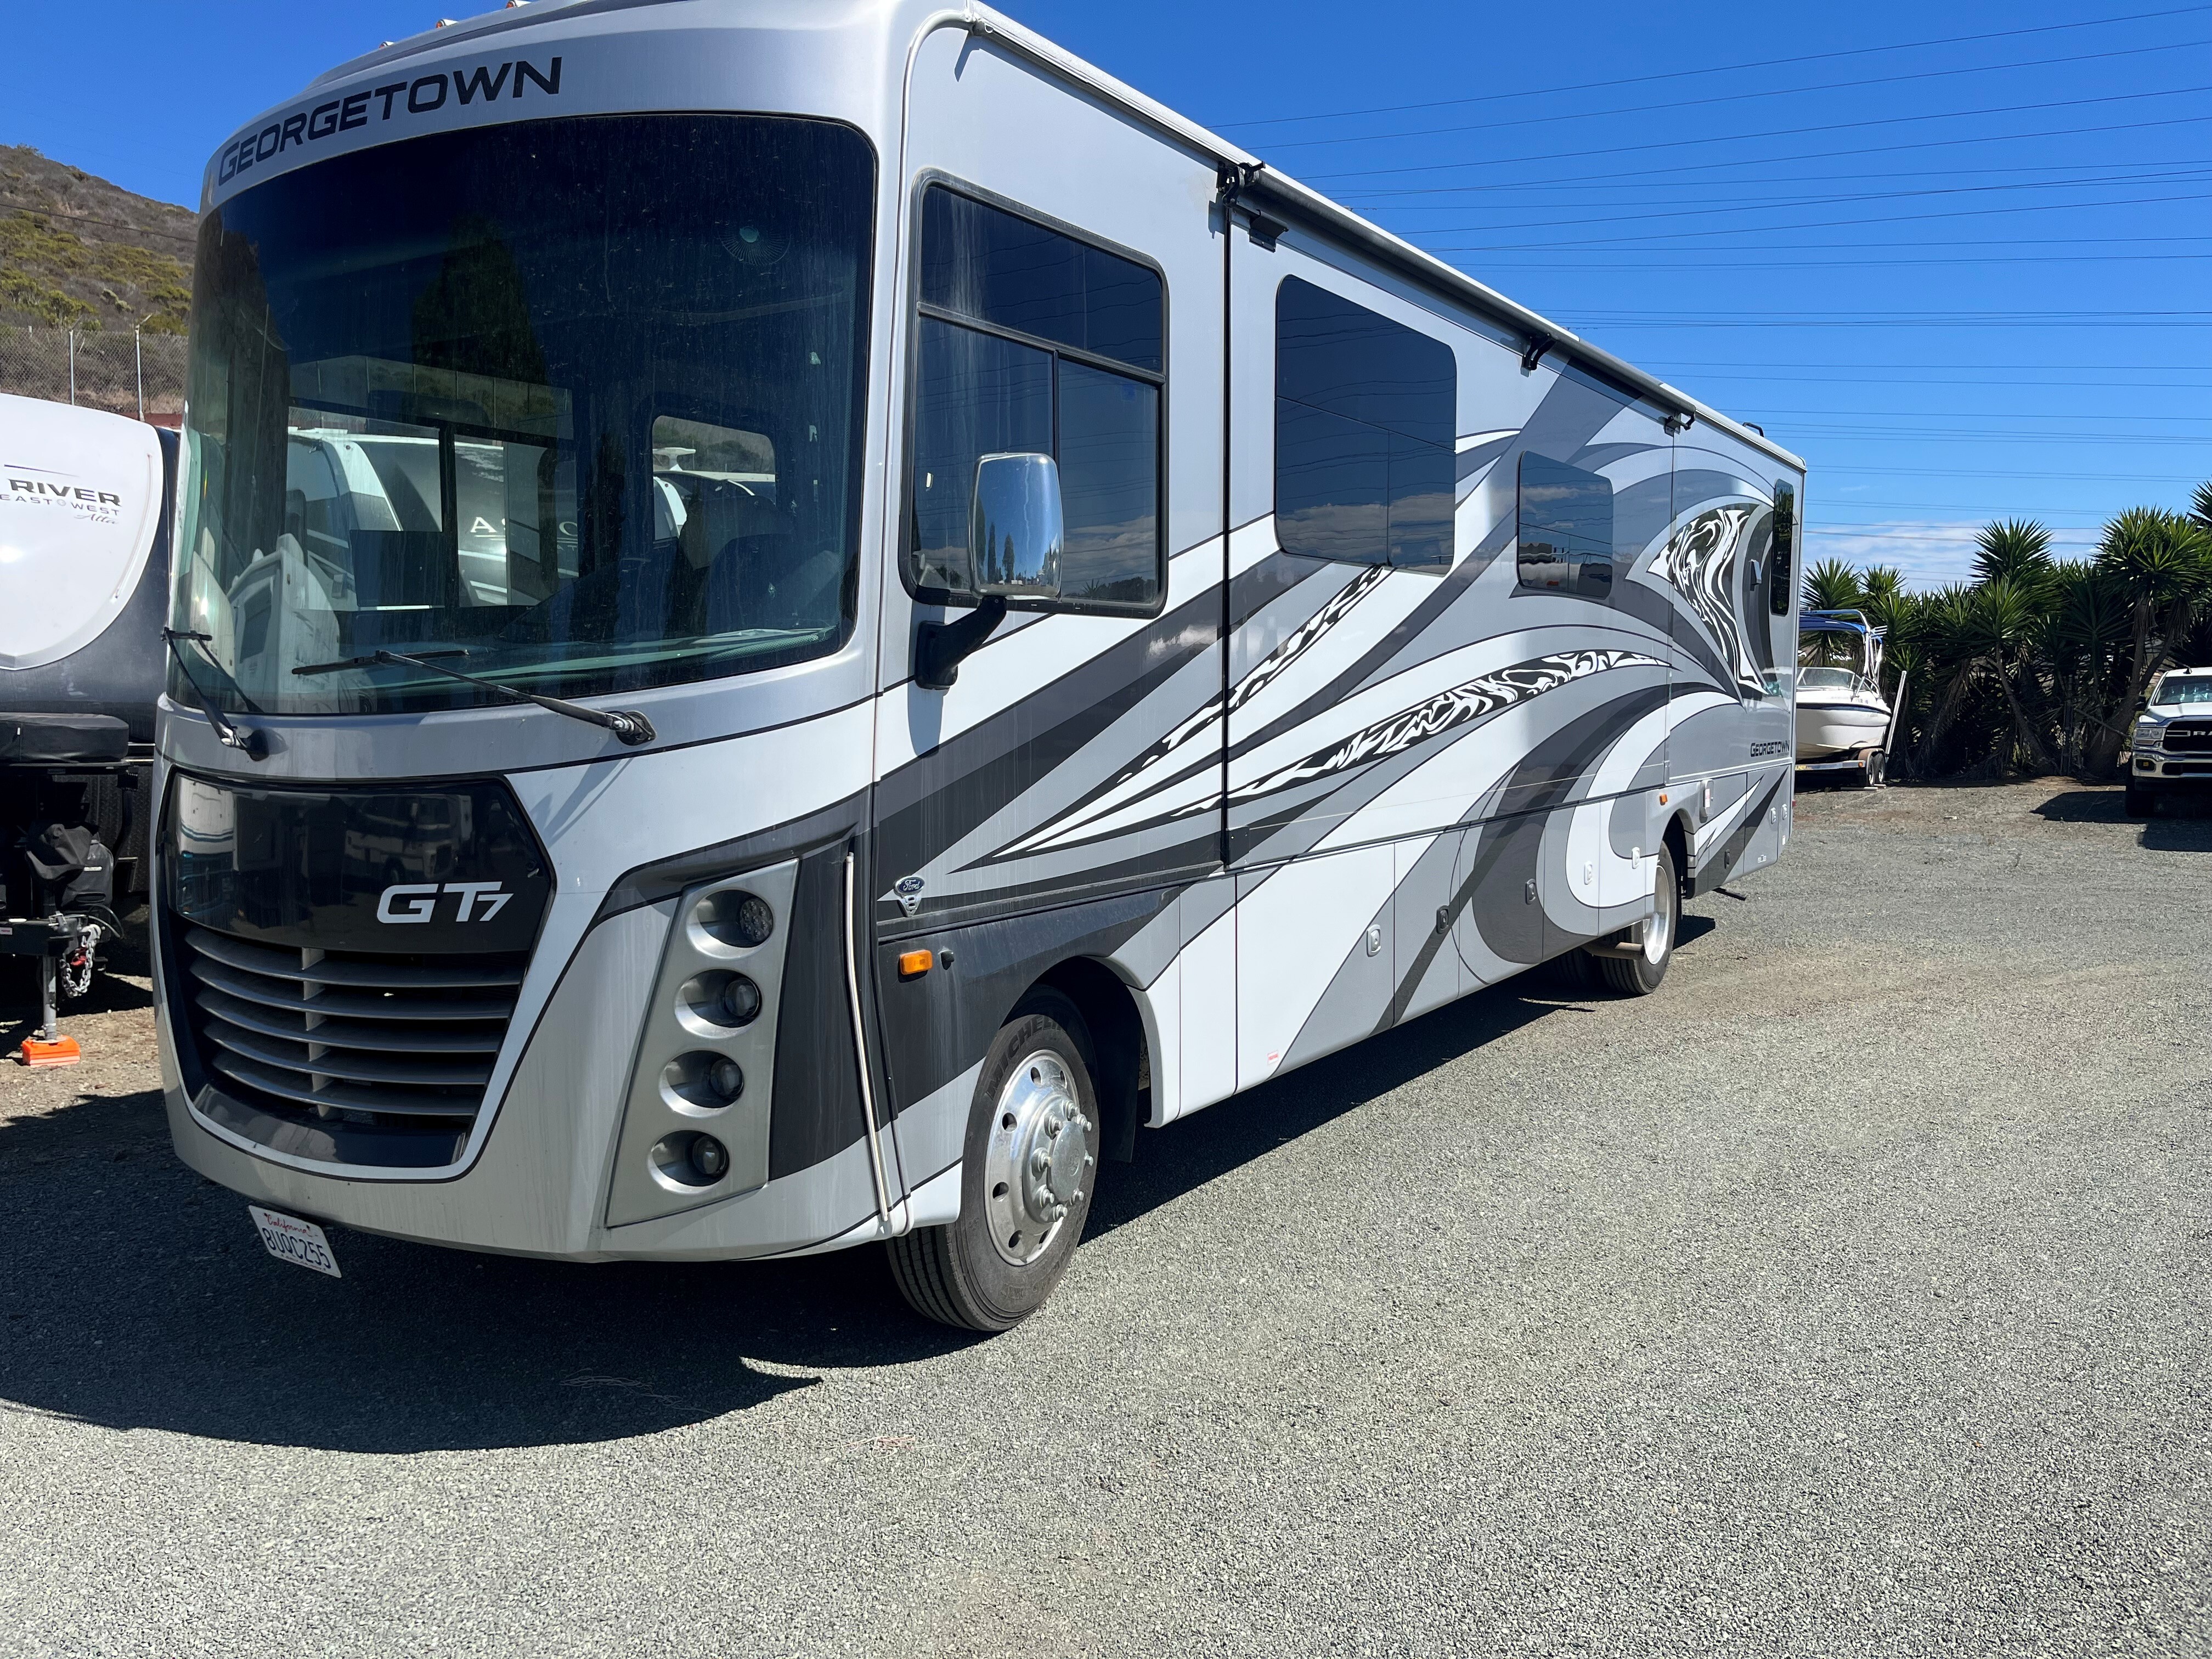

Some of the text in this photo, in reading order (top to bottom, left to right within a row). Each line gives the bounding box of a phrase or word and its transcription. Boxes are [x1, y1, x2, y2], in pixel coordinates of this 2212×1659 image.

[218, 57, 562, 186] GEORGETOWN
[7, 478, 122, 507] RIVER
[0, 494, 120, 516] EAST WEST
[1750, 740, 1790, 757] GEORGETOWN
[903, 879, 921, 891] Ford
[376, 881, 514, 923] GT7
[267, 1214, 309, 1235] California
